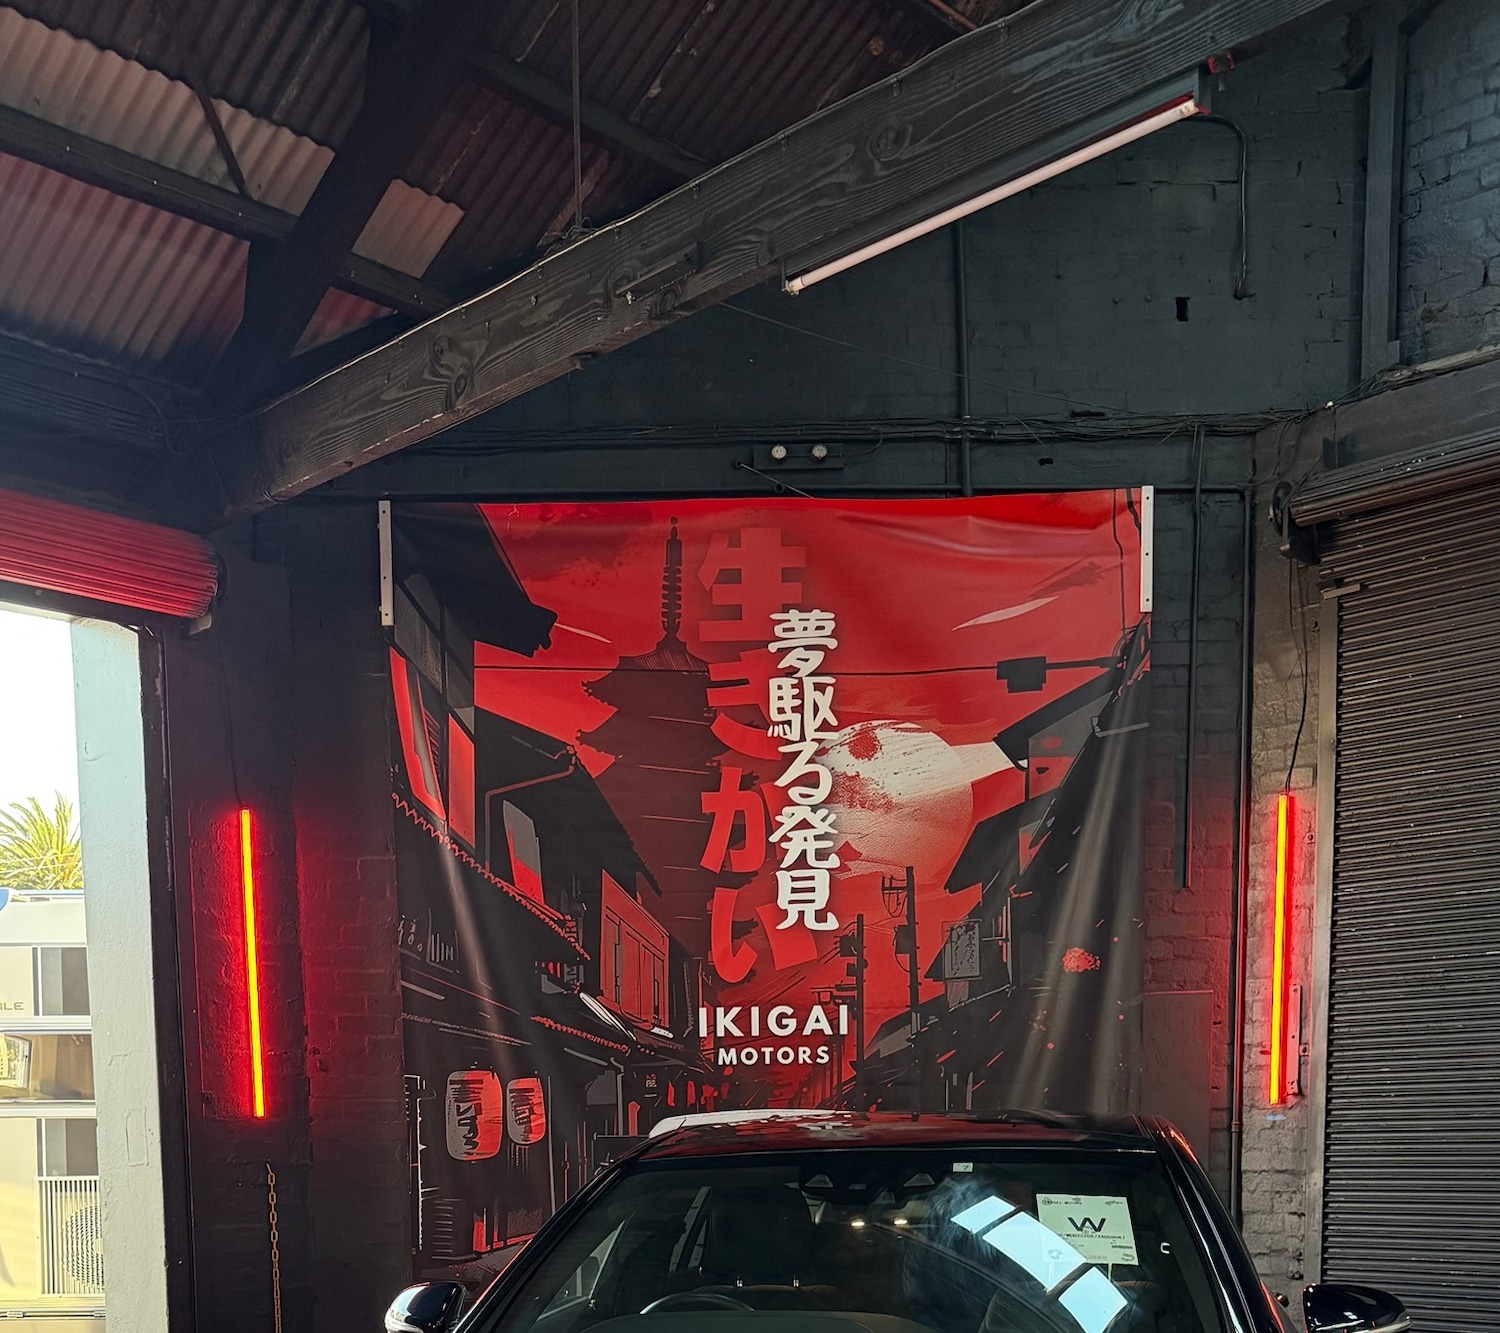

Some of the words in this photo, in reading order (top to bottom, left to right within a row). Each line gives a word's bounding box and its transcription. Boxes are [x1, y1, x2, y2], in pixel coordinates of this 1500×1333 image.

[767, 608, 840, 931] 夢駆る発見
[0, 1001, 24, 1010] LE
[698, 1004, 848, 1037] IKIGAI
[717, 1046, 830, 1066] MOTORS
